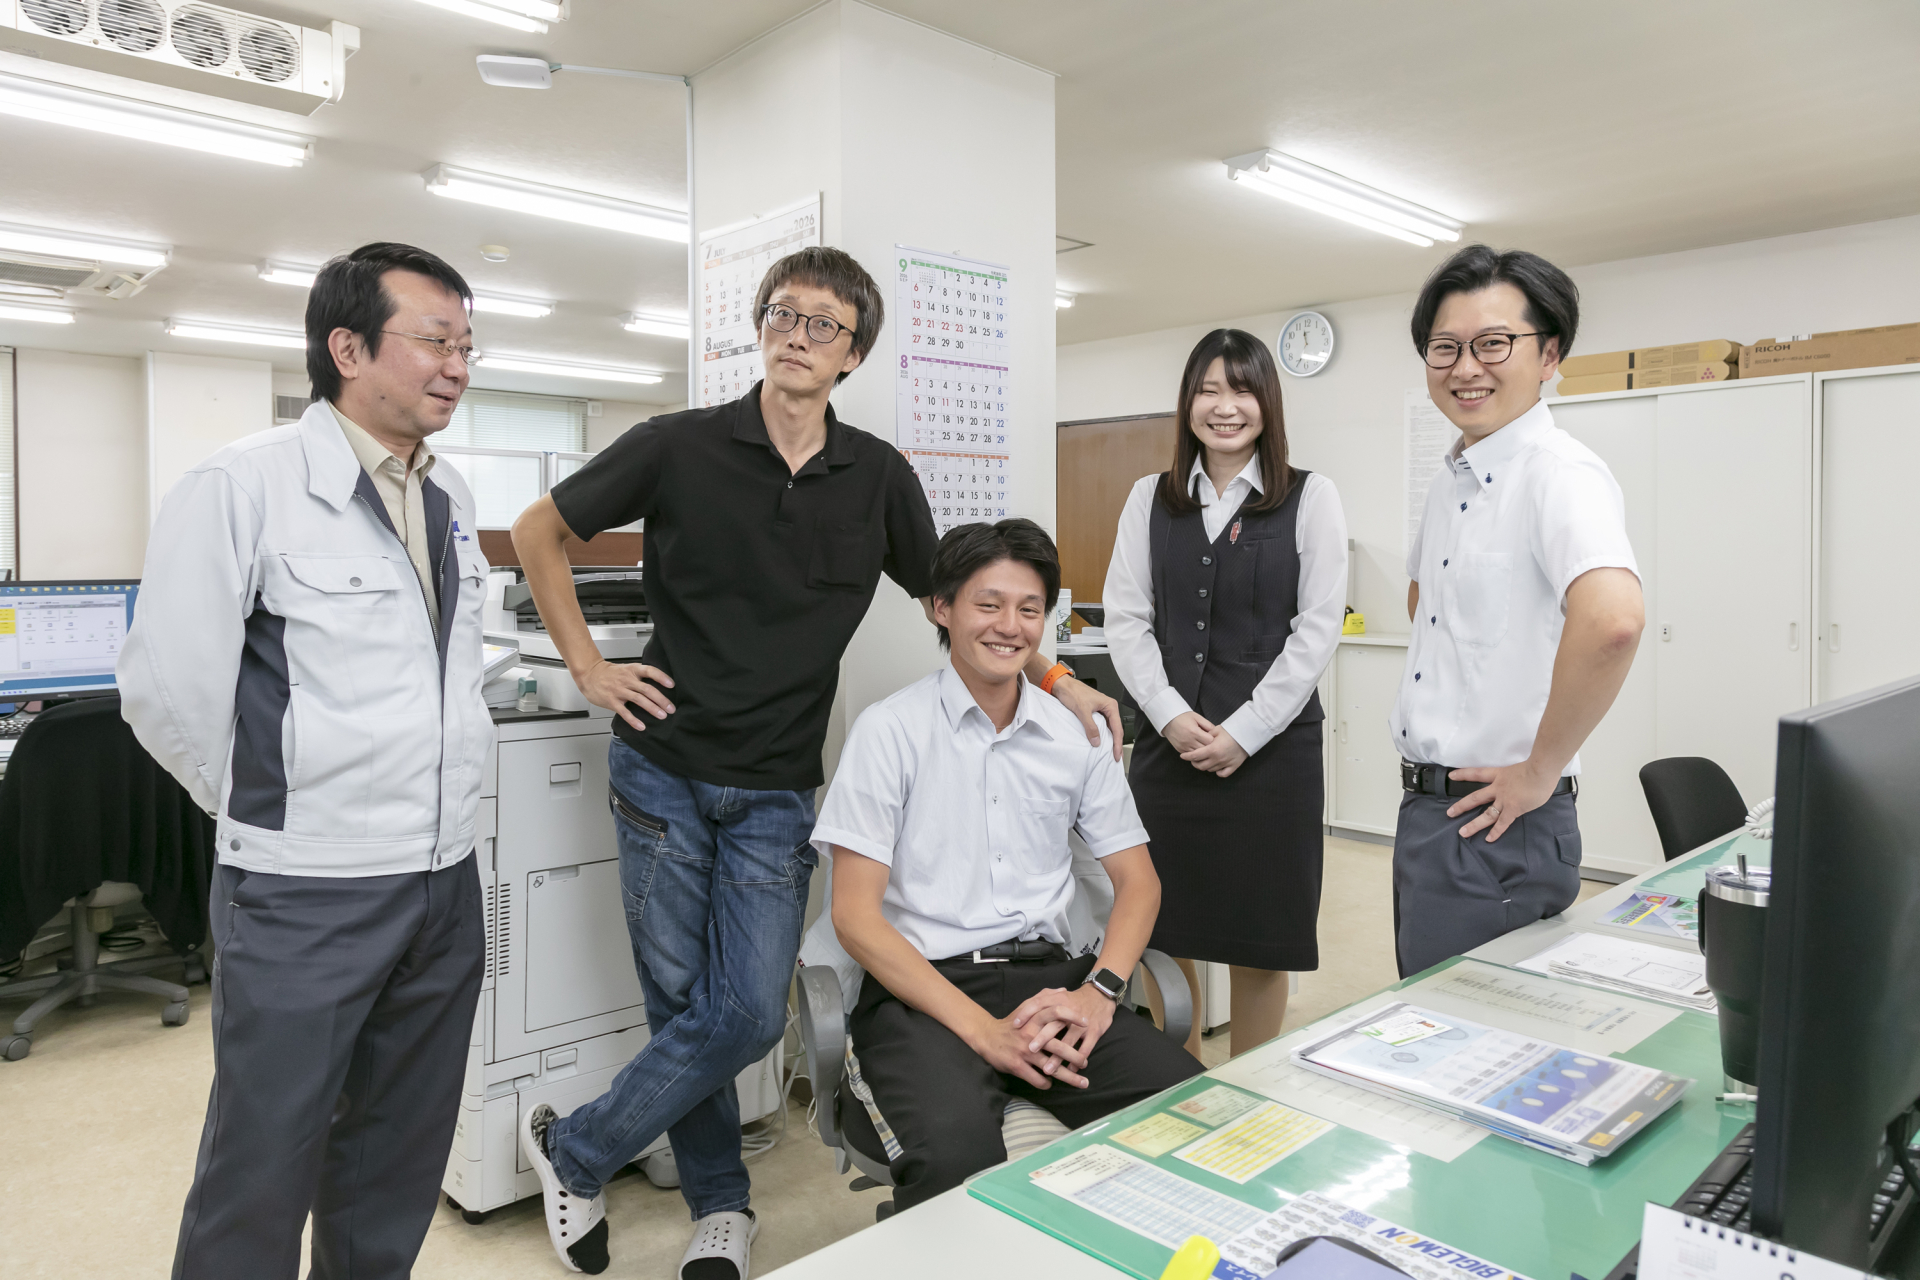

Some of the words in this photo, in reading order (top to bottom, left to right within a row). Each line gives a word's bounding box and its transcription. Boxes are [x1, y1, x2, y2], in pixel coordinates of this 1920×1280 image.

[794, 214, 815, 230] 2026
[706, 244, 712, 259] 7
[714, 248, 726, 257] JULY
[783, 246, 787, 254] 3
[799, 241, 803, 249] 4
[899, 259, 907, 272] 9
[720, 279, 724, 287] 6
[943, 271, 946, 279] 1
[957, 274, 960, 282] 2
[970, 276, 974, 284] 3
[997, 281, 1001, 289] 5
[706, 295, 712, 303] 12
[720, 291, 726, 299] 13
[735, 288, 741, 296] 14
[914, 283, 918, 291] 6
[943, 288, 947, 296] 8
[957, 290, 961, 298] 9
[970, 293, 976, 301] 10
[983, 295, 989, 303] 11
[996, 297, 1003, 305] 12
[706, 308, 712, 316] 19
[913, 300, 920, 309] 13
[928, 302, 935, 311] 14
[942, 305, 949, 313] 15
[956, 307, 963, 315] 16
[970, 309, 976, 317] 17
[983, 312, 990, 320] 18
[996, 314, 1003, 322] 19
[706, 321, 712, 329] 26
[720, 318, 726, 326] 27
[734, 314, 741, 322] 28
[913, 317, 921, 326] 20
[927, 320, 934, 328] 21
[942, 322, 949, 330] 22
[956, 324, 963, 332] 23
[969, 326, 977, 334] 24
[983, 328, 990, 336] 25
[996, 330, 1003, 338] 26
[1296, 323, 1301, 331] 11
[1304, 319, 1311, 327] 12
[1289, 331, 1295, 339] 10
[1322, 327, 1326, 335] 2
[706, 337, 712, 351] 8
[713, 339, 733, 349] AUGUST
[913, 335, 921, 343] 27
[928, 337, 935, 345] 28
[942, 339, 950, 347] 29
[956, 341, 964, 349] 30
[1286, 342, 1290, 350] 9
[1324, 338, 1328, 346] 3
[1755, 344, 1790, 353] RICOH
[900, 354, 908, 369] 8
[1289, 353, 1293, 361] 8
[1304, 361, 1308, 369] 6
[705, 375, 708, 383] 2
[720, 372, 723, 380] 3
[734, 369, 738, 377] 4
[720, 385, 726, 393] 10
[914, 378, 919, 386] 2
[929, 380, 933, 388] 3
[958, 383, 962, 391] 5
[971, 384, 975, 392] 6
[998, 387, 1002, 395] 8
[914, 395, 919, 404] 9
[928, 397, 935, 405] 10
[942, 398, 949, 406] 11
[957, 400, 963, 408] 12
[970, 401, 977, 409] 13
[984, 402, 991, 410] 14
[997, 403, 1004, 411] 15
[914, 413, 921, 421] 16
[928, 414, 935, 422] 17
[943, 415, 950, 423] 18
[957, 416, 964, 424] 19
[970, 418, 978, 426] 20
[997, 420, 1004, 428] 22
[943, 432, 950, 440] 25
[957, 433, 964, 441] 26
[970, 434, 978, 442] 27
[984, 435, 991, 443] 28
[997, 436, 1004, 444] 29
[986, 459, 990, 467] 2
[999, 460, 1003, 468] 3
[930, 474, 934, 482] 5
[998, 476, 1004, 484] 10
[929, 490, 936, 498] 12
[943, 491, 950, 499] 13
[971, 492, 978, 500] 15
[984, 492, 992, 500] 16
[943, 508, 951, 516] 20
[957, 508, 964, 516] 21
[971, 508, 978, 516] 22
[984, 508, 992, 516] 23
[1376, 1228, 1505, 1278] BIGLEMON
